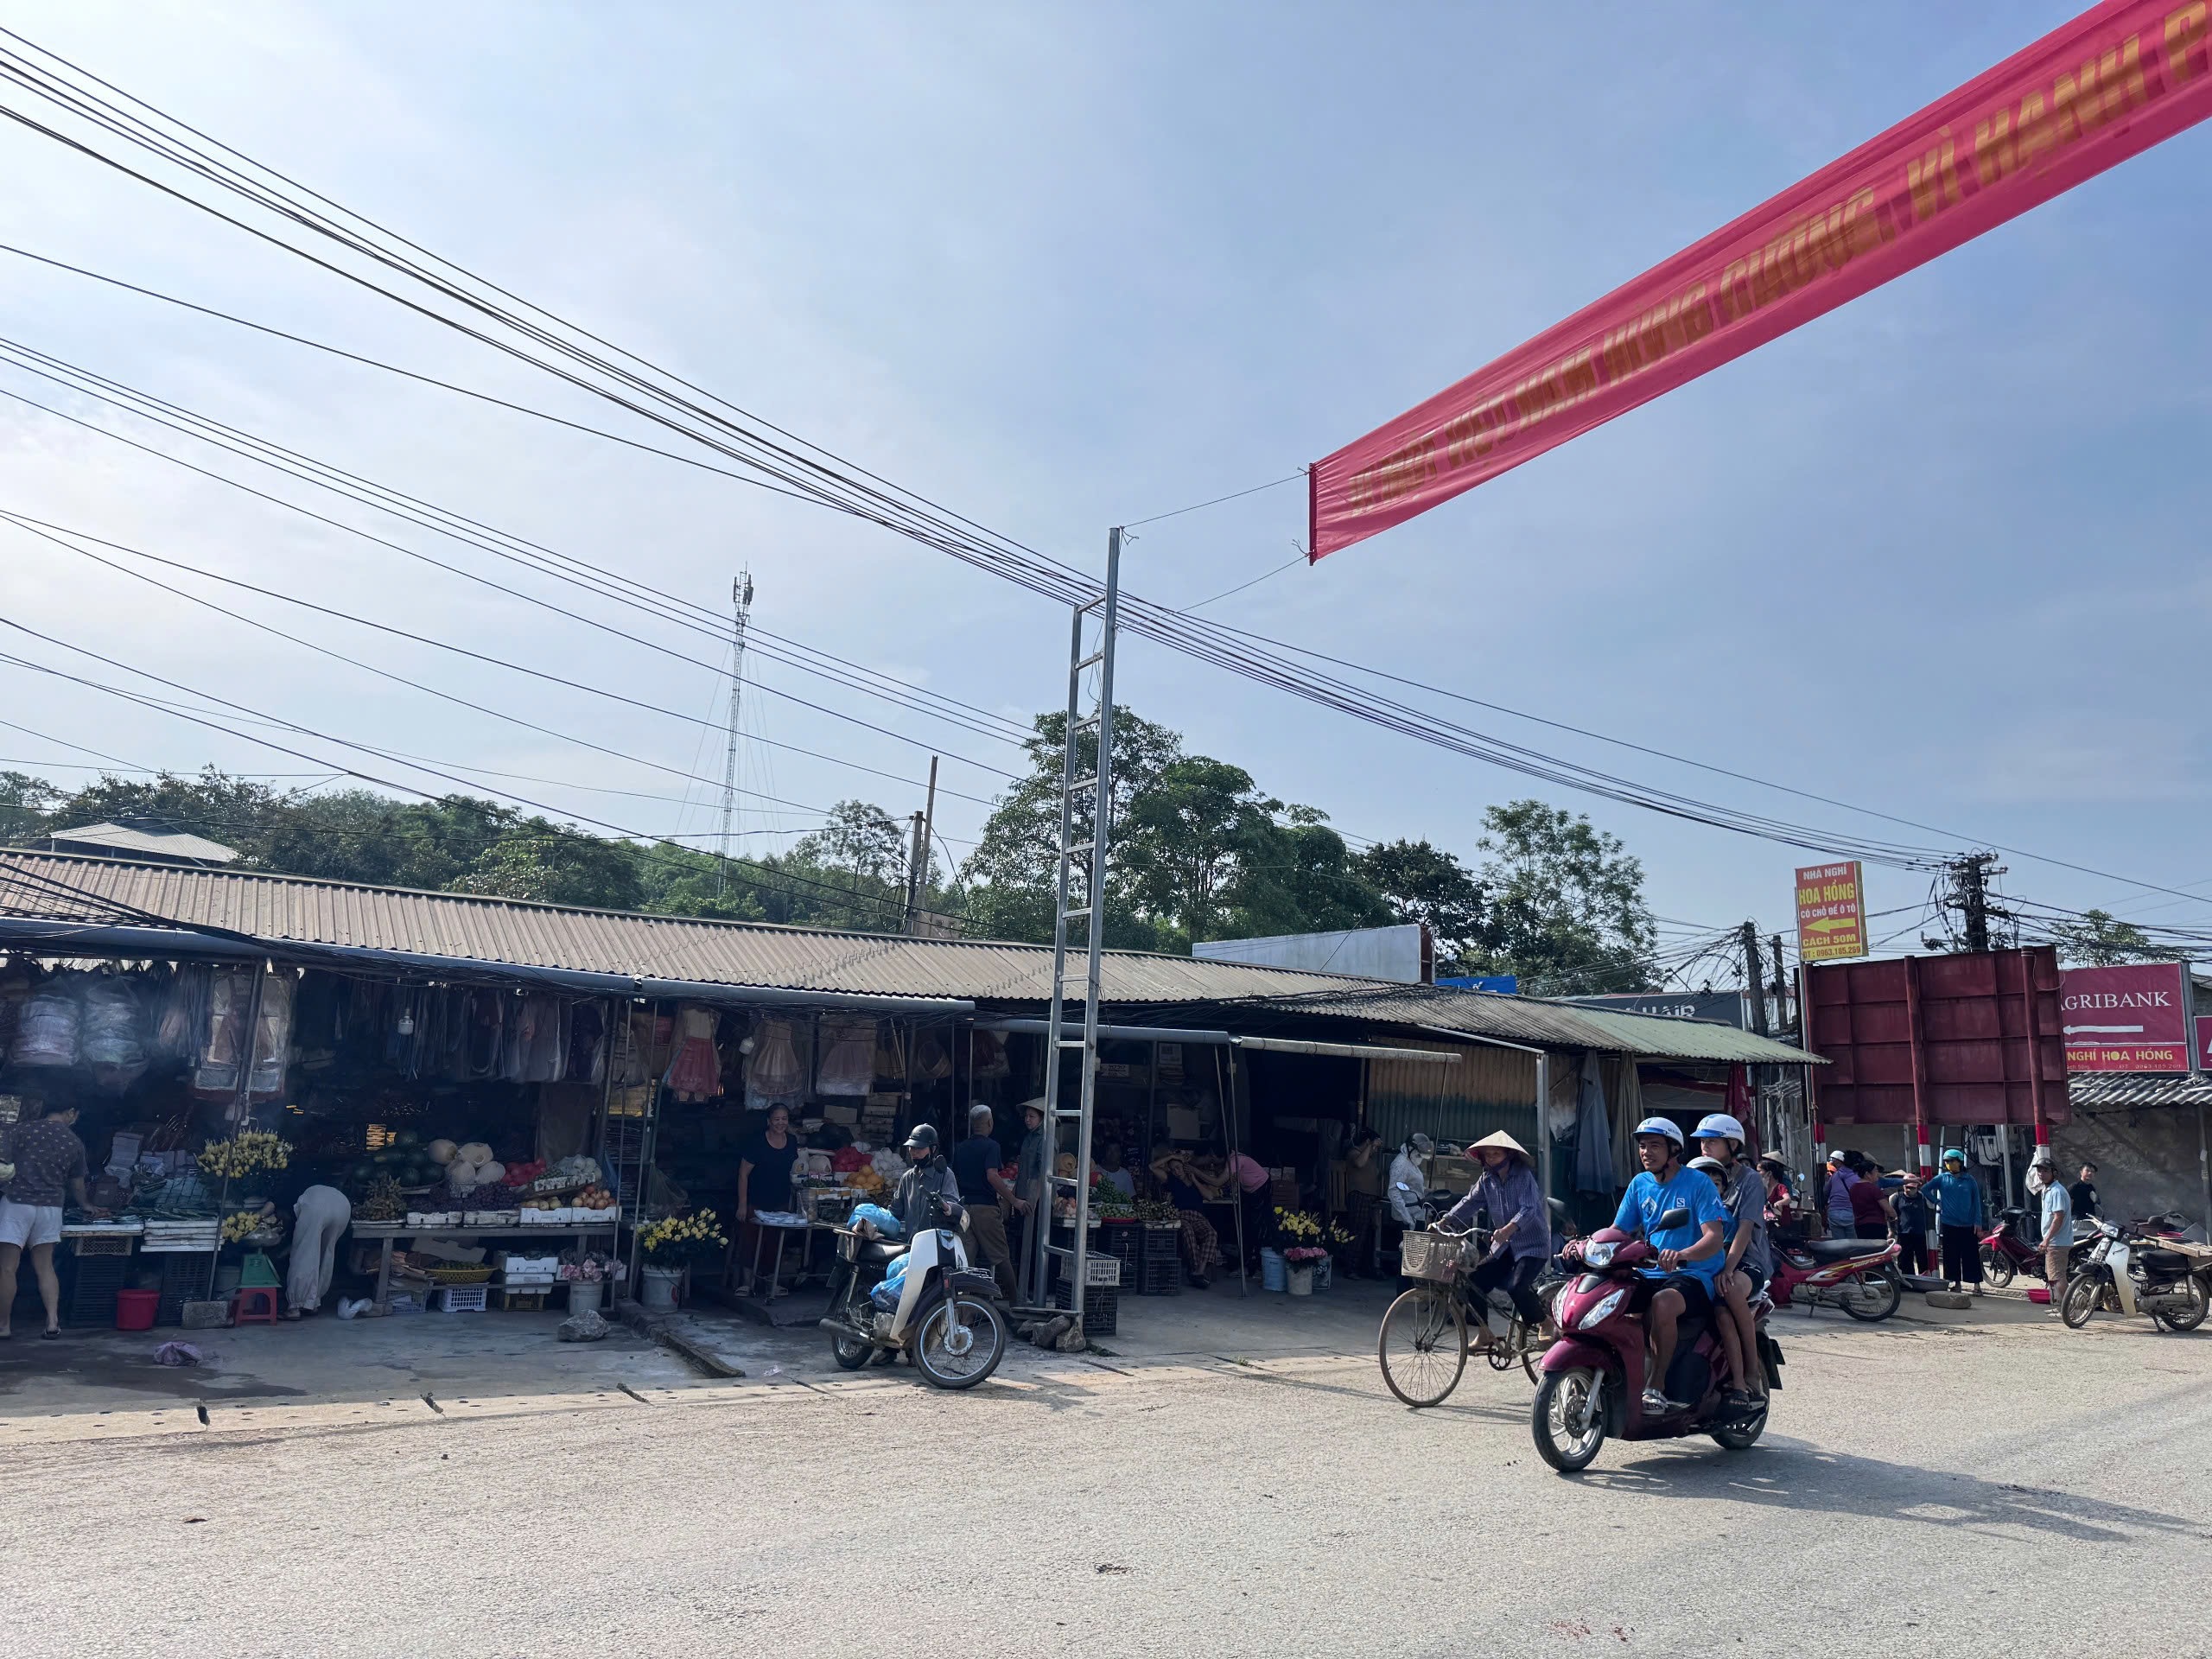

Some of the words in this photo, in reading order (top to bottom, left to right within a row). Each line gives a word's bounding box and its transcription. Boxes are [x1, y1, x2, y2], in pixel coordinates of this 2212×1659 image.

[1515, 346, 1598, 432] NAM
[1907, 125, 1961, 222] VÌ
[1975, 34, 2148, 187] HẠNH
[1803, 868, 1822, 880] NHÀ
[1825, 863, 1847, 877] NGHỈ
[1798, 887, 1821, 905] HOA
[1823, 879, 1854, 901] HỒNG
[1801, 908, 1810, 918] CÓ
[1840, 904, 1845, 913] Ô
[1847, 904, 1856, 913] TÔ
[1802, 935, 1830, 946] CÁCH
[1834, 934, 1856, 944] 50M
[2061, 991, 2171, 1012] GRIBANK
[2102, 1051, 2130, 1061] HOA
[2135, 1047, 2173, 1061] HỒNG
